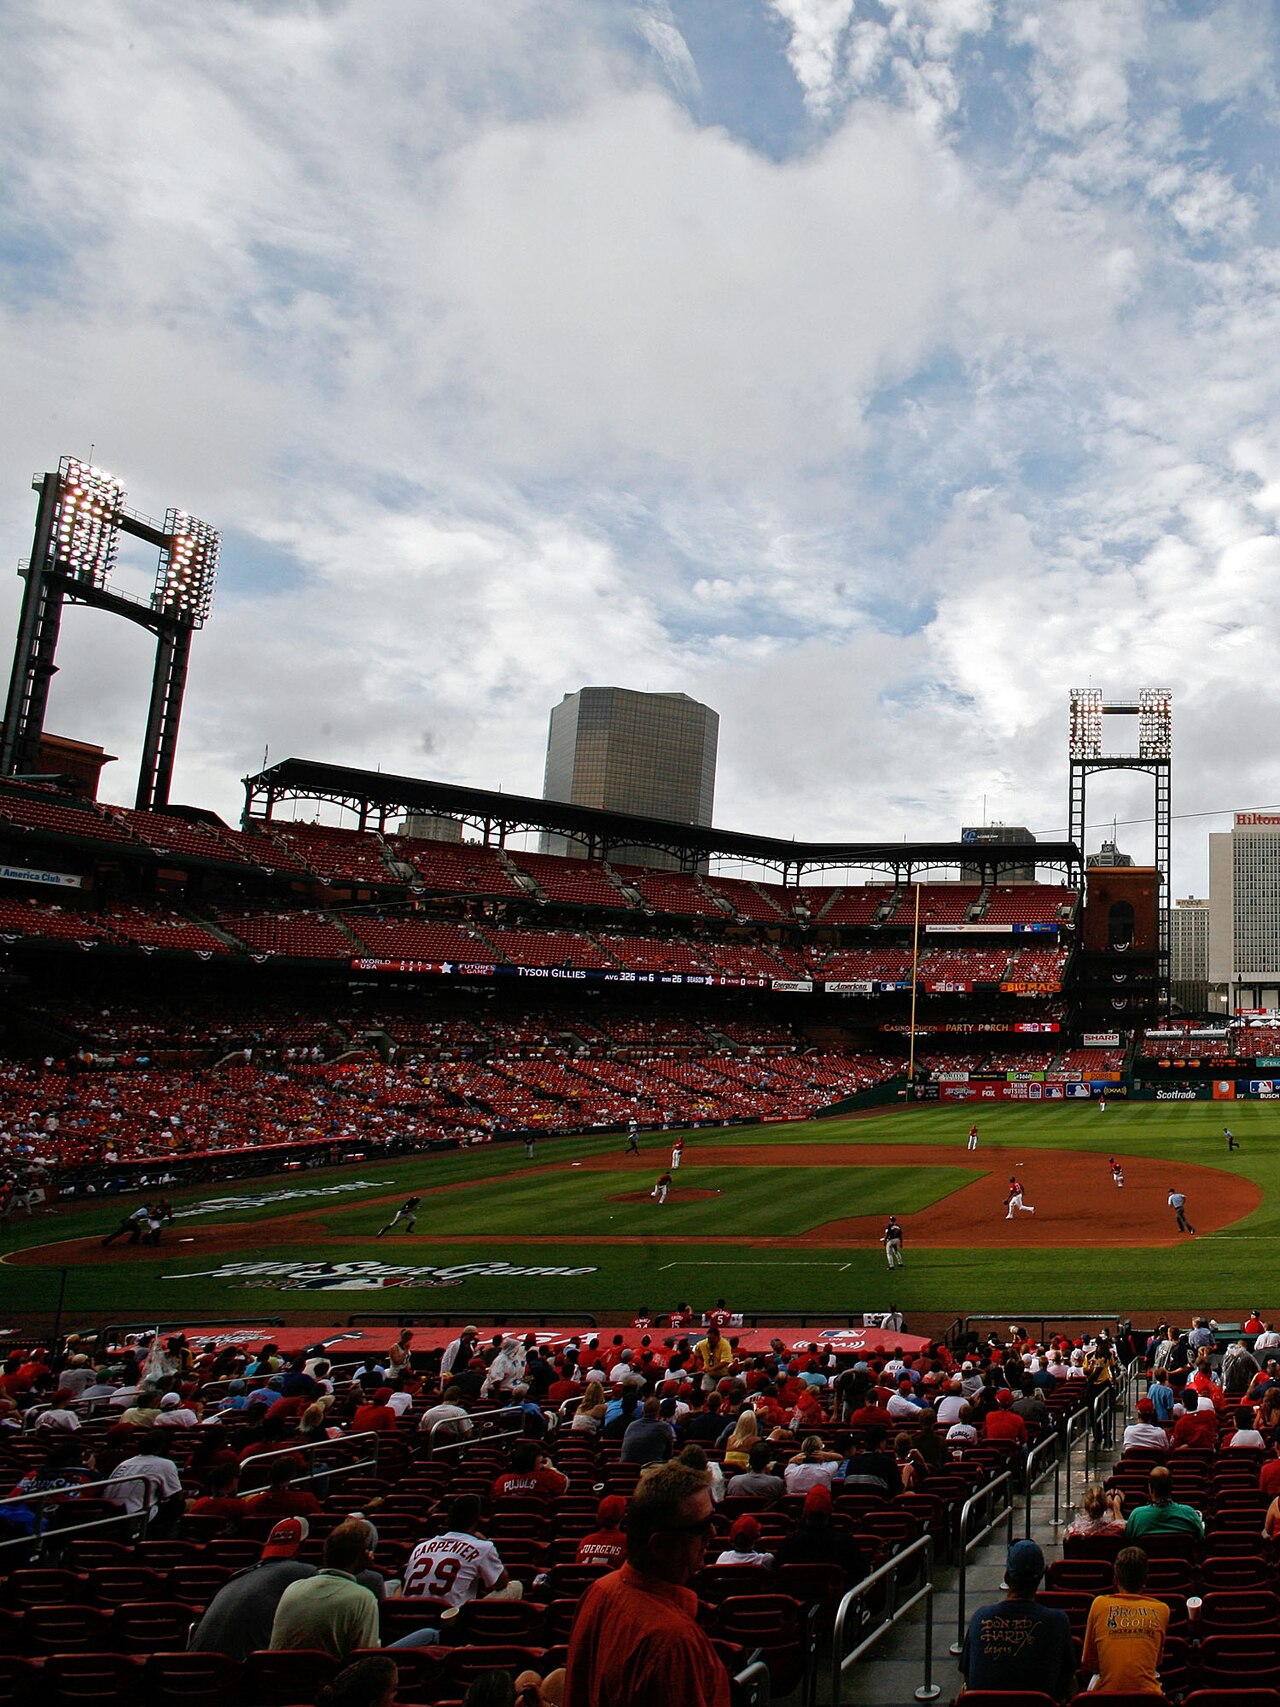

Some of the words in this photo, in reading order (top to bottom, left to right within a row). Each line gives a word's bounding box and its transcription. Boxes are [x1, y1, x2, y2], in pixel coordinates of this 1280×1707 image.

[1236, 813, 1280, 825] Hilton
[3, 868, 40, 882] America
[41, 872, 61, 884] Club
[458, 963, 496, 971] FUTURES
[517, 967, 549, 978] TYSON
[552, 968, 587, 980] GILLIES
[648, 973, 655, 982] 6
[672, 975, 682, 984] 26
[686, 976, 705, 984] SEASON
[772, 981, 799, 990] Energizer
[1007, 983, 1026, 992] BIG
[1027, 983, 1055, 992] MAC
[884, 1024, 910, 1032] CASINO
[946, 1024, 975, 1032] PARTY
[981, 1089, 996, 1097] FOX
[1156, 1090, 1197, 1100] Scottrade
[290, 1260, 439, 1280] Star
[437, 1261, 599, 1278] Game
[717, 1316, 724, 1326] 5
[504, 1478, 537, 1493] PUJOLS
[413, 1541, 480, 1563] CARPENTER
[580, 1543, 623, 1556] JUERGENS
[405, 1557, 461, 1597] 29
[980, 1630, 1032, 1644] HARDY
